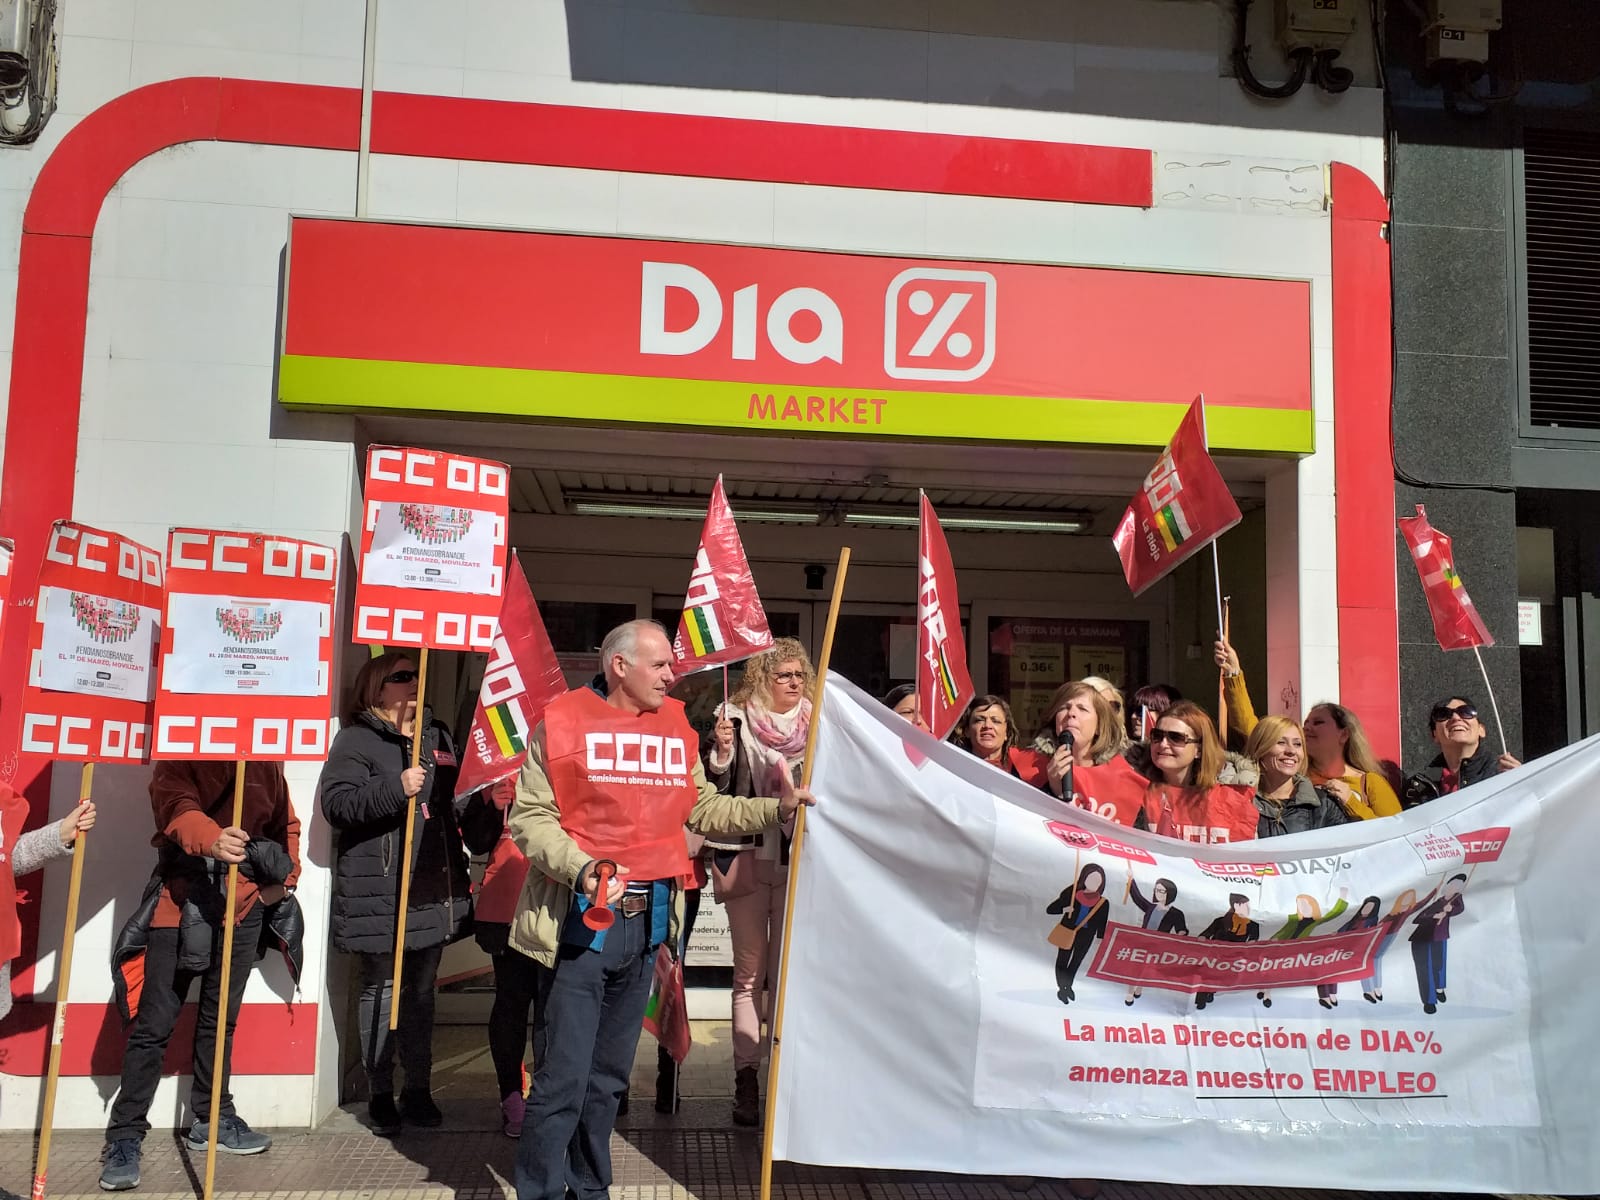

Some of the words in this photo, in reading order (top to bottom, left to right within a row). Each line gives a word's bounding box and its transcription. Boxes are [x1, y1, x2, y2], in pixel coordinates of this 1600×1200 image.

[747, 393, 888, 425] MARKET
[1145, 531, 1160, 561] Rioja
[1013, 625, 1047, 635] OFERTA
[1049, 627, 1061, 636] DE
[1064, 627, 1077, 636] LA
[1079, 628, 1120, 637] SEMANA
[473, 728, 490, 765] Rioja
[585, 733, 687, 774] CCOO
[587, 774, 627, 784] comisiones
[628, 776, 654, 785] obreras
[655, 778, 664, 786] de
[664, 778, 672, 786] la
[673, 778, 688, 788] Rioj
[1051, 827, 1091, 840] STOP
[1414, 835, 1456, 848] PLANTILLA
[1100, 841, 1149, 857] CCOO
[1425, 853, 1437, 861] EN
[1437, 849, 1462, 859] LUCHA
[1438, 843, 1451, 851] DIA
[1280, 856, 1353, 875] DIA%
[1201, 870, 1262, 886] servicios
[1063, 1019, 1095, 1042] La
[1104, 1022, 1166, 1046] mala
[1173, 1024, 1308, 1050] Dirección
[1316, 1028, 1351, 1051] de
[1360, 1029, 1443, 1055] DIA%
[1068, 1064, 1188, 1087] amenaza
[1196, 1067, 1304, 1090] nuestro
[1312, 1068, 1437, 1094] EMPLEO
